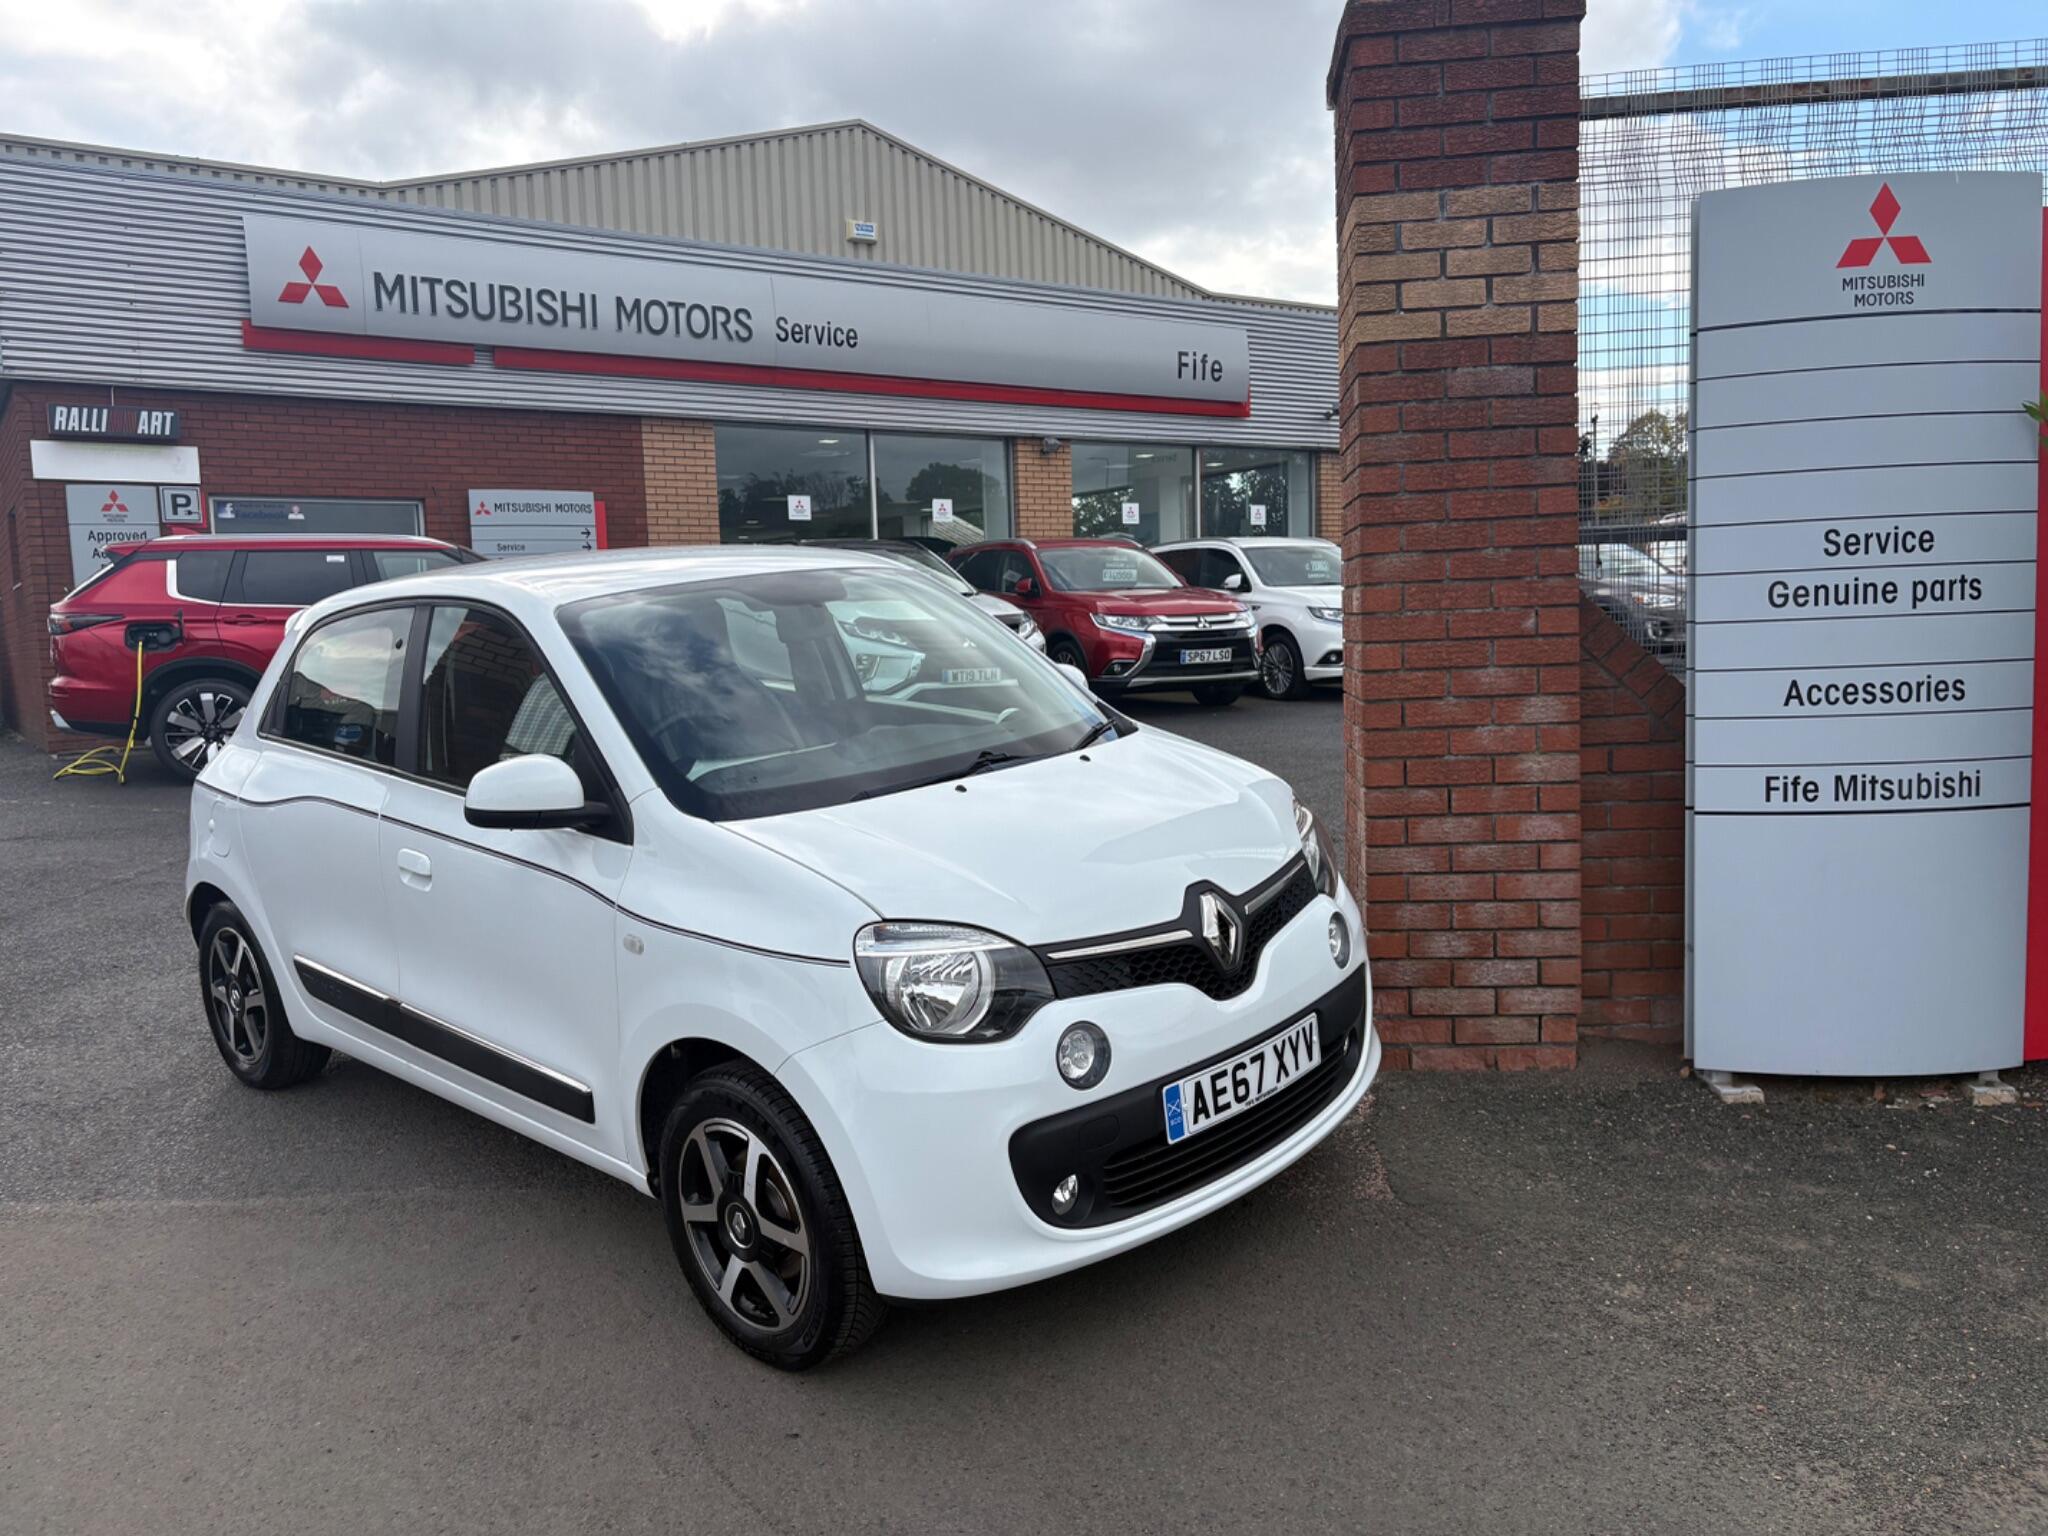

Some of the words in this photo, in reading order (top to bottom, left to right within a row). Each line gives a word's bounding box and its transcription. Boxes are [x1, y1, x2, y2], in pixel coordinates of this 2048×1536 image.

[1842, 273, 1925, 291] MITSUBISHI
[373, 271, 599, 330] MITSUBISHI
[615, 296, 754, 343] MOTORS
[1854, 291, 1914, 307] MOTORS
[775, 315, 859, 349] Service
[1177, 351, 1223, 382] Fife
[54, 406, 108, 433] RALLI
[137, 410, 174, 435] ART
[170, 494, 191, 515] P
[494, 502, 552, 513] MITSUBISHI
[555, 503, 592, 514] MOTORS
[88, 530, 147, 543] Approved
[497, 543, 526, 552] Service
[1823, 525, 1935, 557] Service
[1768, 577, 1899, 608] Genuine
[1911, 574, 1983, 610] parts
[1783, 674, 1966, 707] Accessories
[1764, 776, 1820, 804] Fife
[1833, 770, 1981, 803] Mitsubishi
[1193, 1051, 1266, 1125] AE67
[1273, 1022, 1313, 1084] XYV
